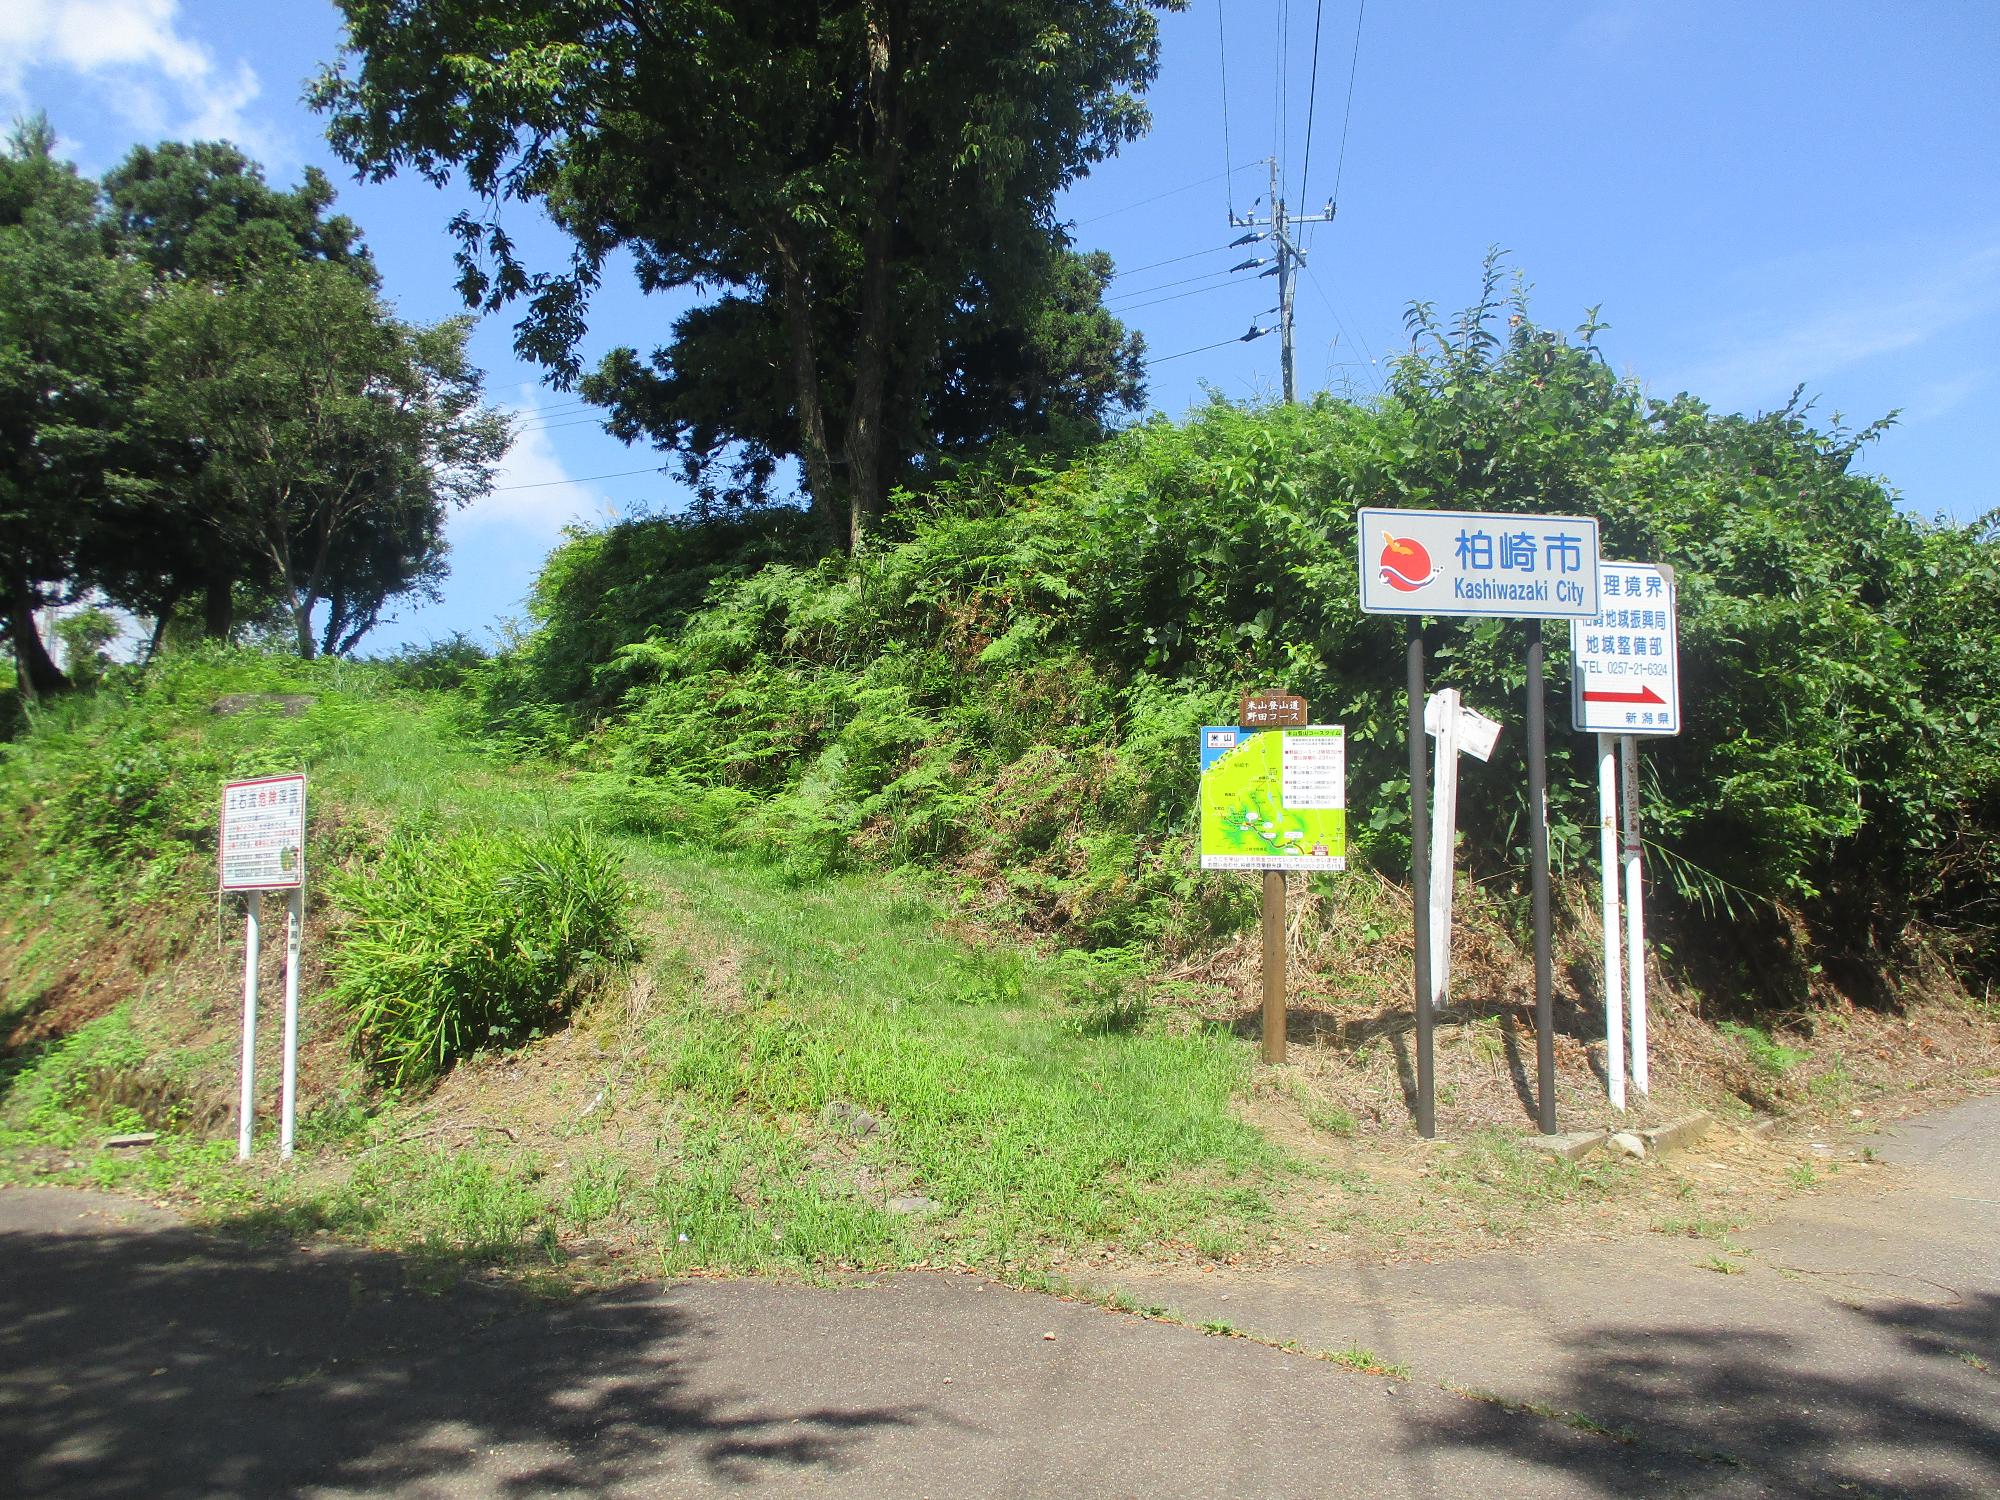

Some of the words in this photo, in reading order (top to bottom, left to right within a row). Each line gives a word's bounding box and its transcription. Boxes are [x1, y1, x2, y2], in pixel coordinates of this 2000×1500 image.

[1455, 529, 1582, 573] 柏崎市
[1455, 577, 1548, 601] Kashiwazaki
[1556, 580, 1584, 606] City
[1586, 635, 1663, 656] 地域整備部
[1582, 660, 1602, 674] TEL
[1608, 661, 1667, 676] 0257-21-6324
[1247, 700, 1300, 711] 米山登山道
[1247, 712, 1299, 721] 野田コース
[1625, 712, 1669, 725] 新潟県
